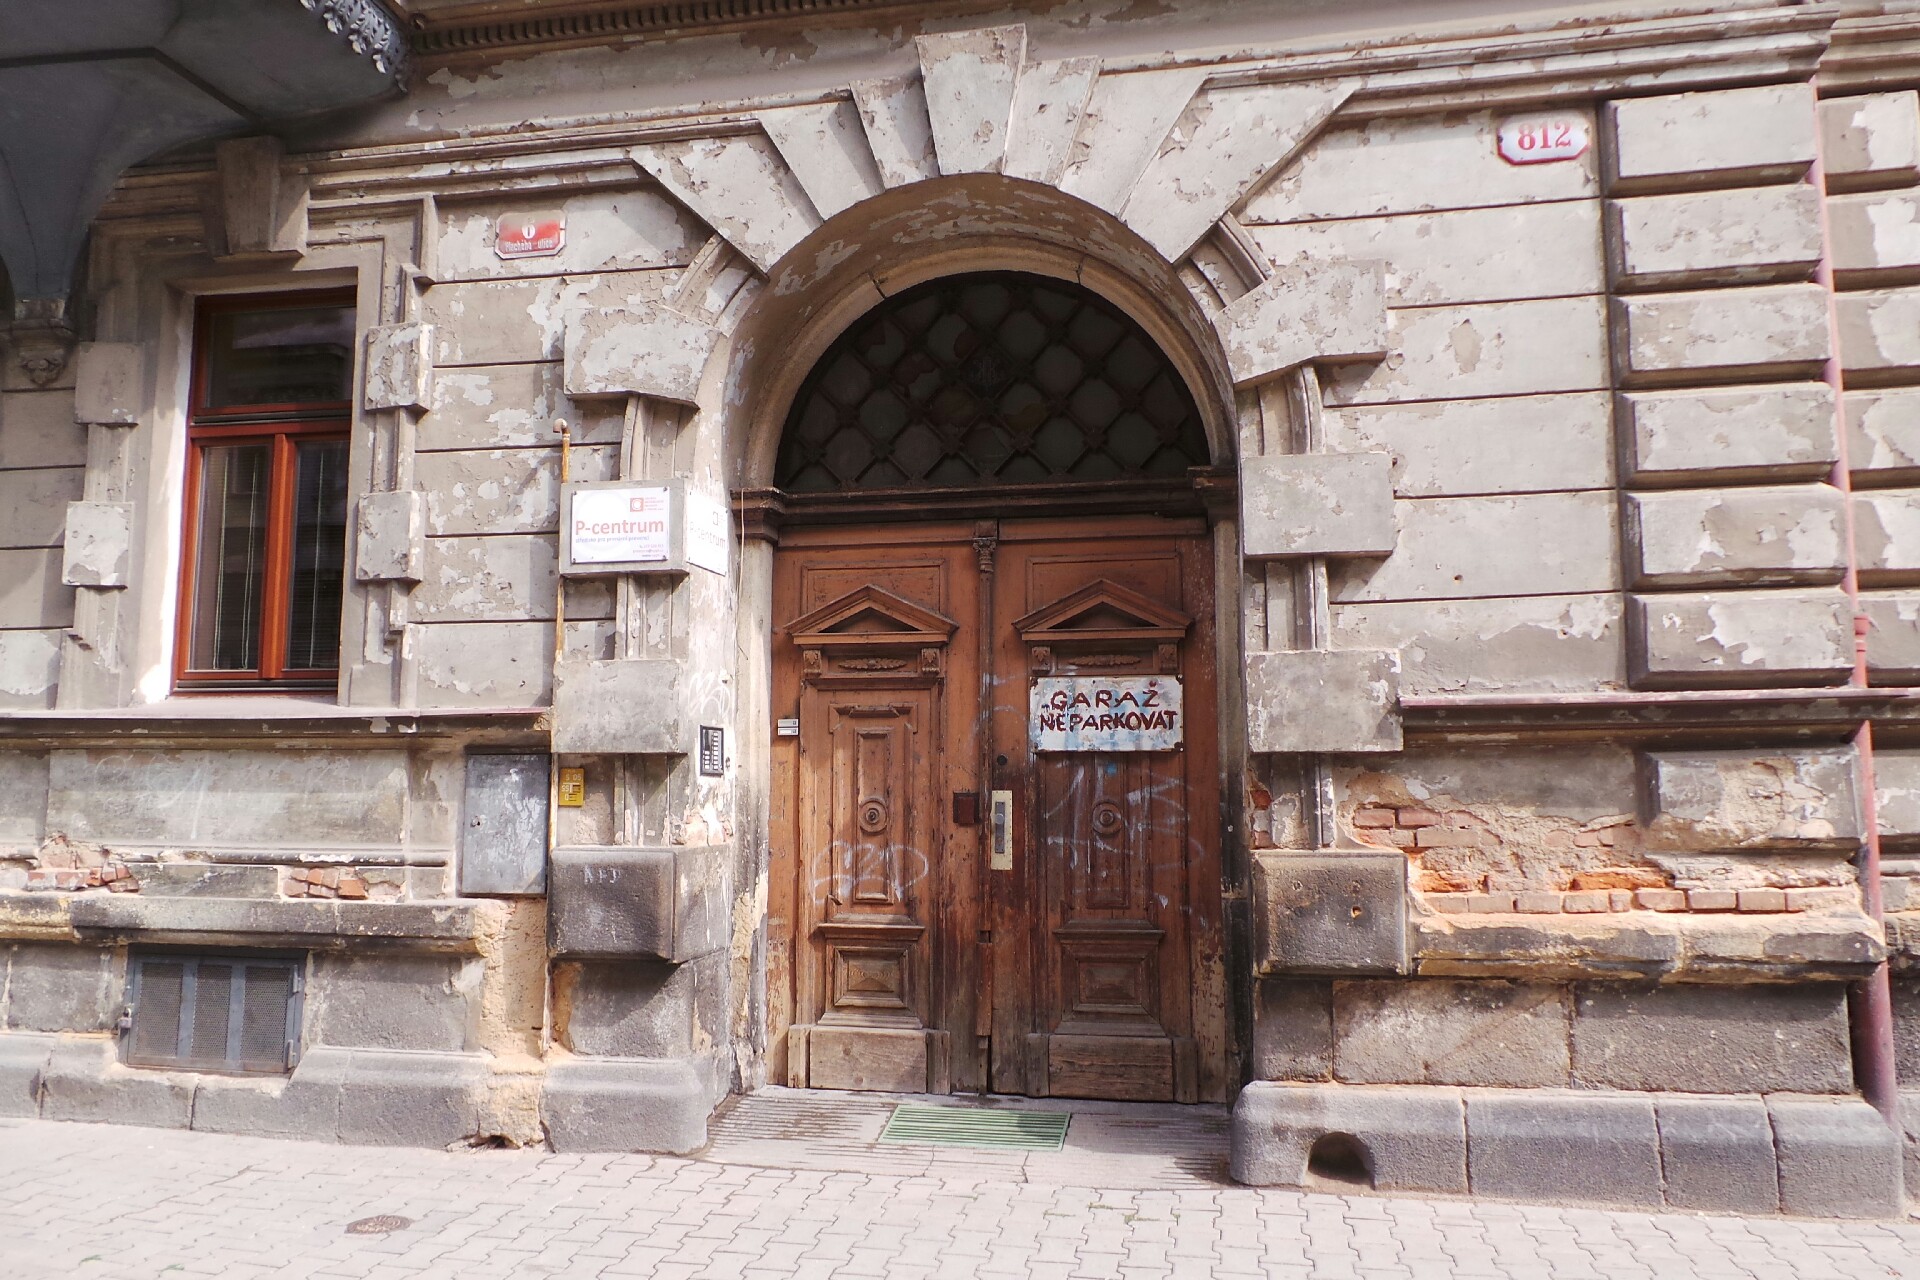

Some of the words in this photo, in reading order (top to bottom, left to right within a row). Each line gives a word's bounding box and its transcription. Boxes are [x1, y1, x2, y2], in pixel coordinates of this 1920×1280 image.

[1517, 120, 1571, 151] 812
[575, 519, 664, 536] P-centrum
[1040, 710, 1178, 733] NEPARKOVAT
